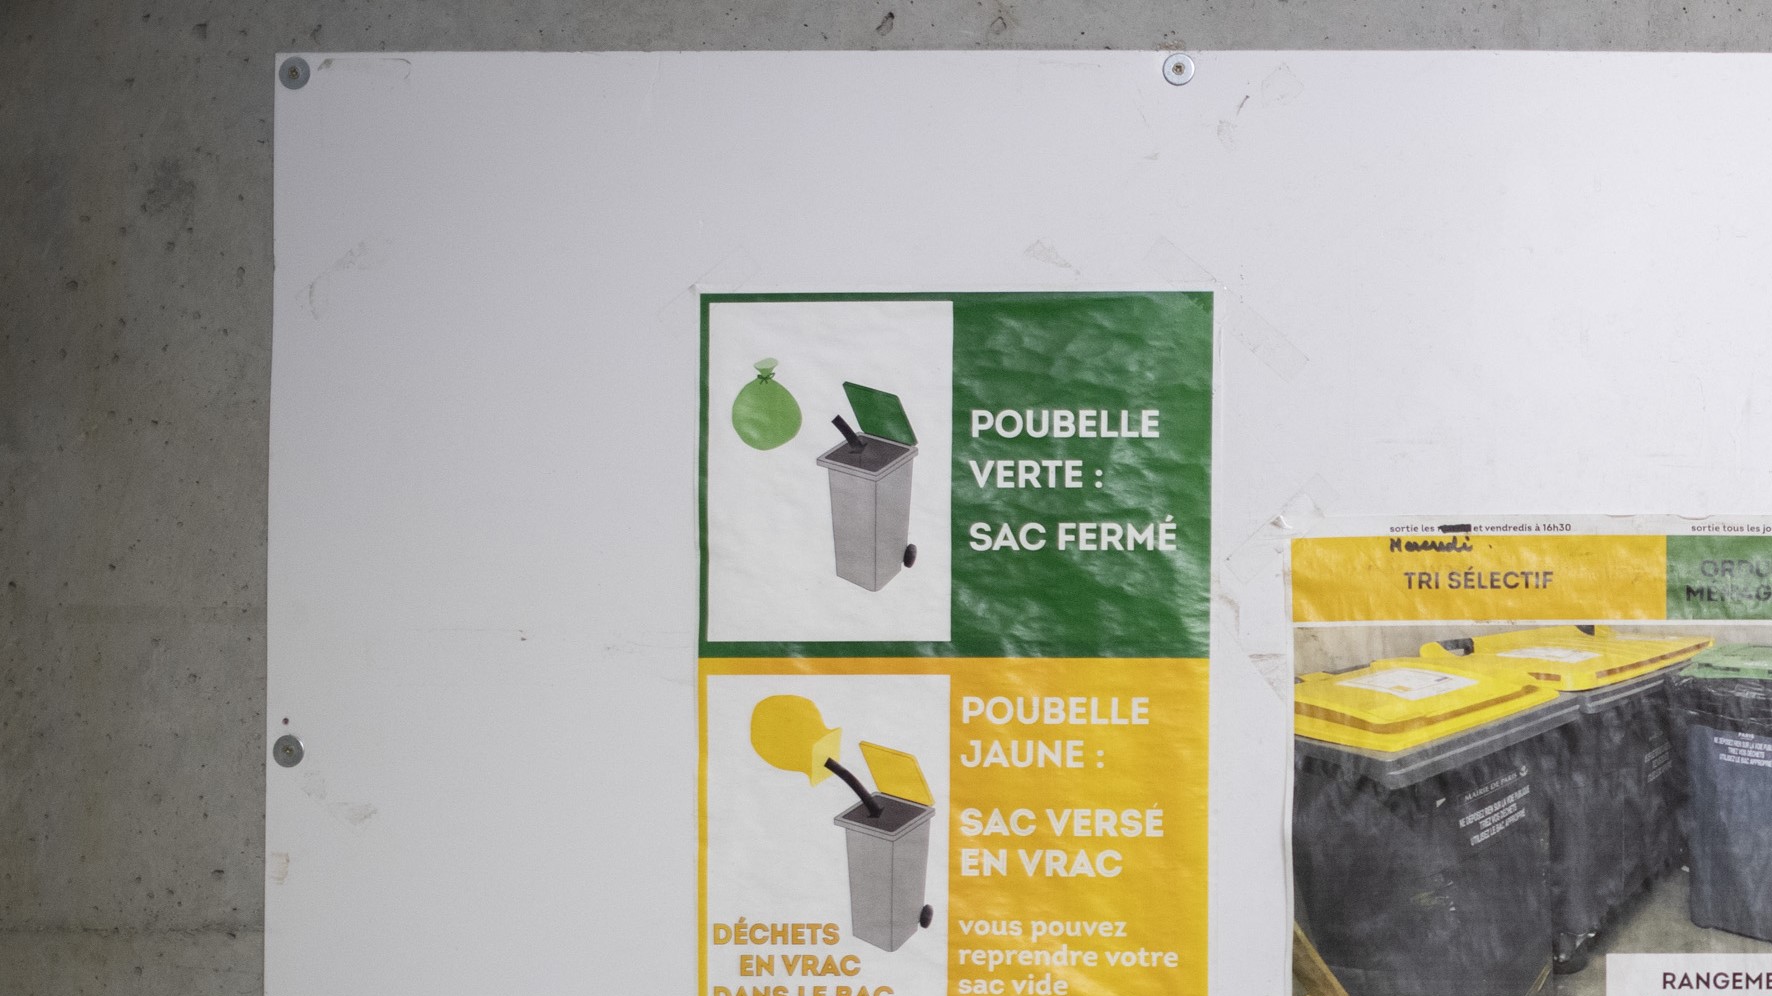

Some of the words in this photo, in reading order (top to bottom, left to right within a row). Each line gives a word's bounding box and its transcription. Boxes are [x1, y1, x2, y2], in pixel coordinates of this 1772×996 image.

[972, 410, 1159, 438] POUBELLE
[968, 460, 1082, 488] VERTE
[970, 522, 1046, 551] SAC
[1058, 505, 1176, 551] FERMÉ
[1422, 524, 1434, 532] les
[1691, 524, 1720, 532] sortie
[1722, 524, 1744, 532] tous
[1747, 524, 1760, 532] les
[1404, 572, 1439, 589] TRI
[1448, 566, 1553, 589] SÉLECTIF
[963, 695, 1149, 724] POUBELLE
[961, 740, 1083, 768] JAUNE
[959, 808, 1036, 837] SAC
[1046, 799, 1163, 837] VERSÉ
[960, 849, 1010, 877] EN
[1018, 849, 1122, 877] VRAC
[713, 917, 840, 945] DÉCHETS
[959, 920, 1022, 938] vous
[1030, 921, 1126, 943] pouvez
[740, 955, 770, 976] EN
[775, 955, 861, 977] VRAC
[958, 944, 1098, 972] reprendre
[1105, 948, 1178, 967] votre
[958, 979, 1004, 994] sac
[1011, 973, 1068, 996] vide
